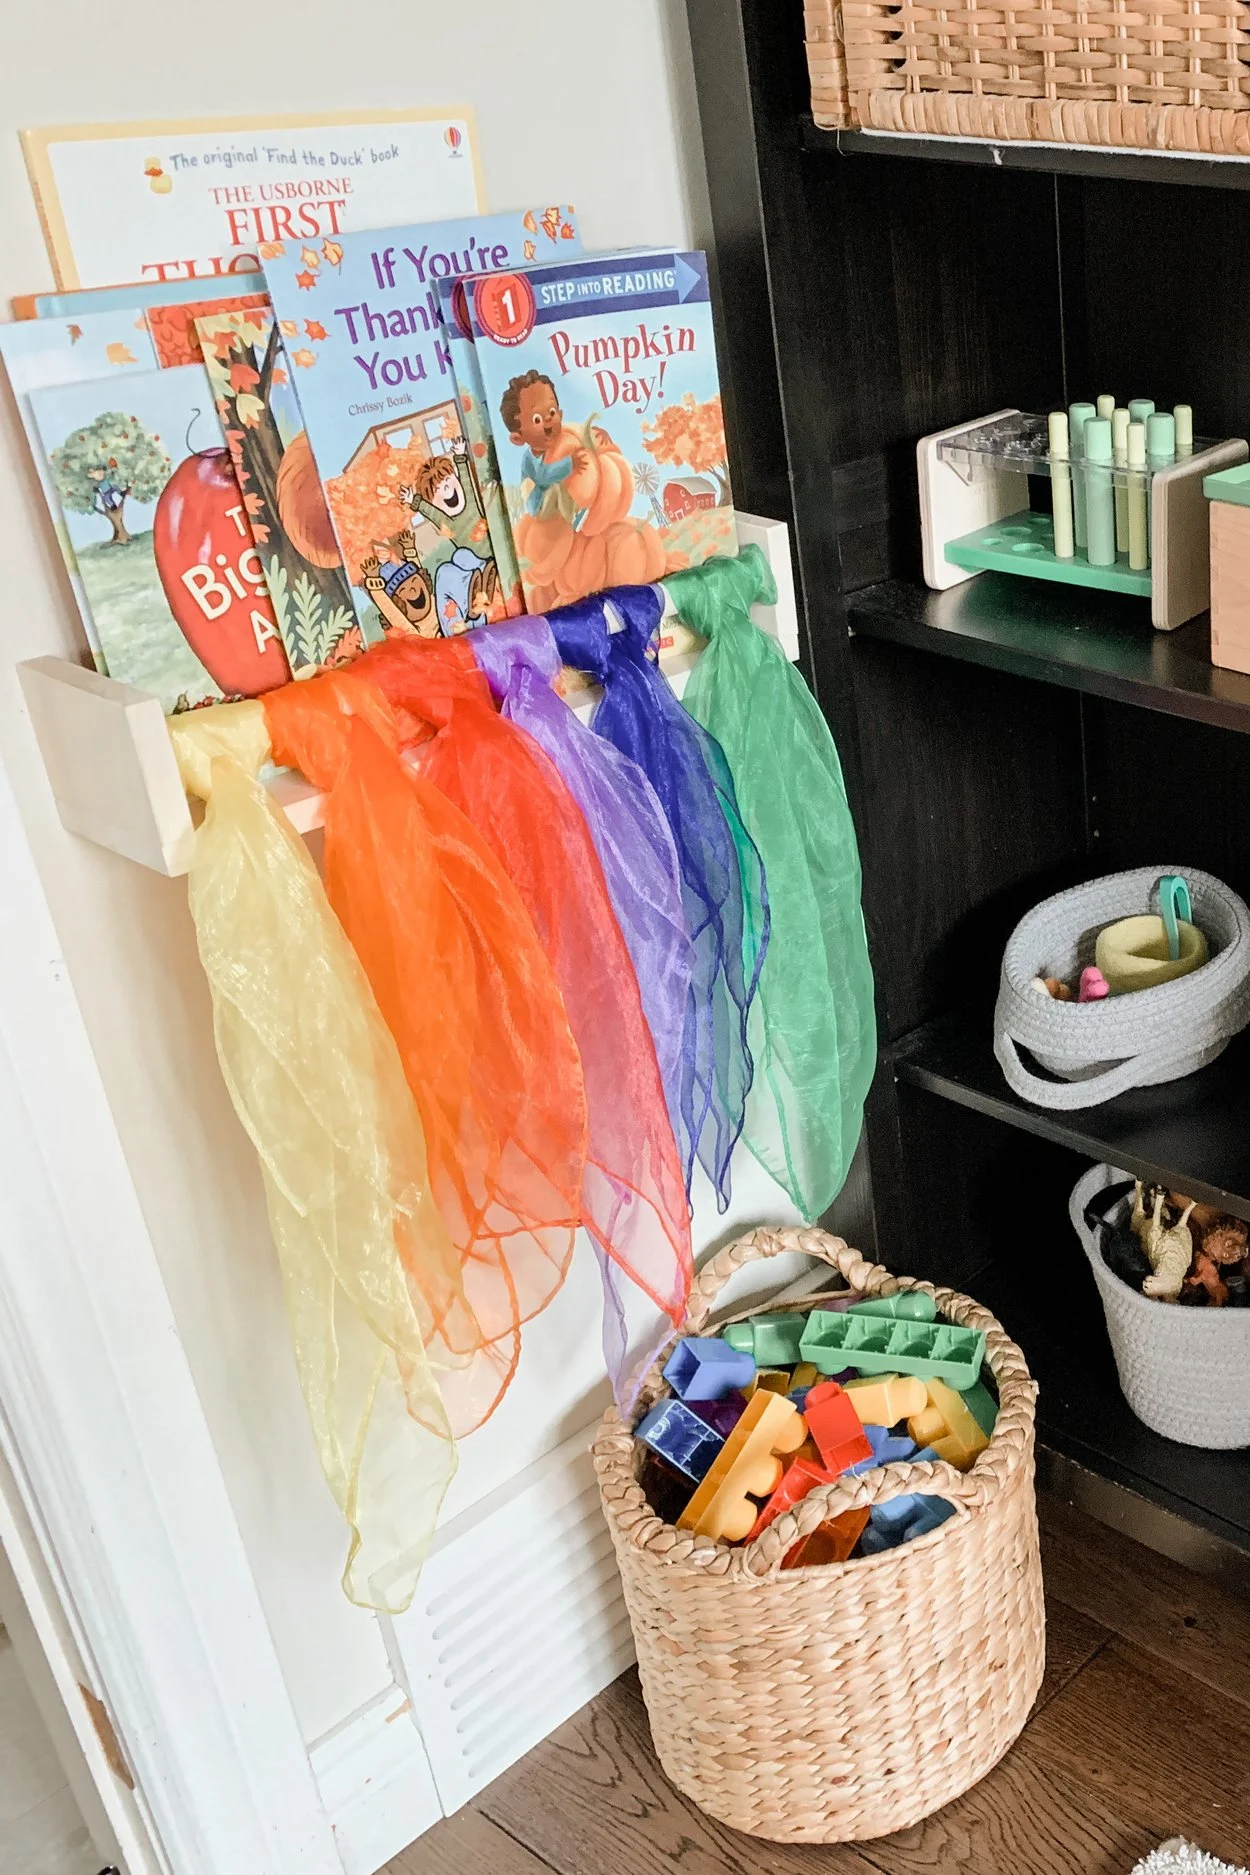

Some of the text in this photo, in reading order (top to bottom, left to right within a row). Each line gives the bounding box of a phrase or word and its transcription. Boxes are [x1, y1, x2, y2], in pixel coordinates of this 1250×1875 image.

[169, 152, 198, 171] The
[203, 145, 258, 168] original
[302, 150, 325, 166] the
[370, 144, 399, 164] book
[208, 177, 354, 205] THE USBORNE
[224, 199, 346, 246] FIRST
[371, 236, 510, 289] If You're
[541, 269, 676, 304] STEP INTO READING
[502, 289, 516, 324] 1
[548, 323, 696, 376] Pumpkin
[353, 351, 428, 390] You
[592, 361, 667, 414] Day!
[348, 393, 413, 416] Chrissy Bozik
